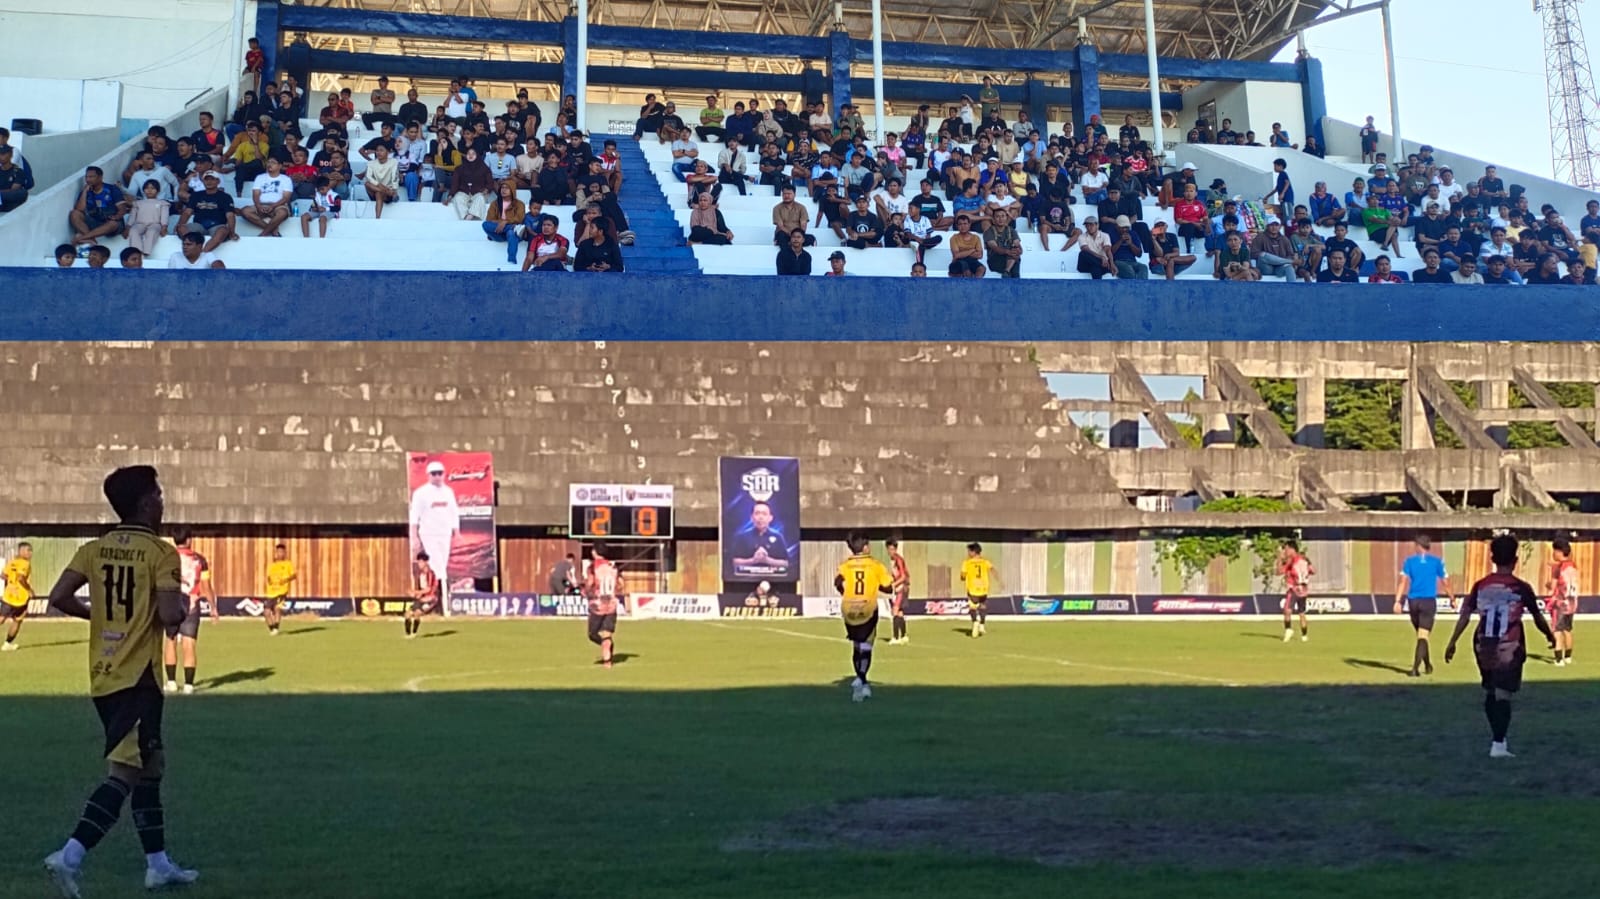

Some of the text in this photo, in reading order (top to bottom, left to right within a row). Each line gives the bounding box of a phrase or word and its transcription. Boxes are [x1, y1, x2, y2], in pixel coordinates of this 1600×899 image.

[611, 390, 621, 404] 7
[624, 424, 632, 435] 5
[631, 440, 639, 450] 4
[637, 456, 646, 469] 3
[591, 506, 611, 536] 2
[637, 506, 657, 536] 0
[102, 564, 135, 624] 14
[855, 571, 865, 595] 8
[1485, 605, 1510, 638] 11
